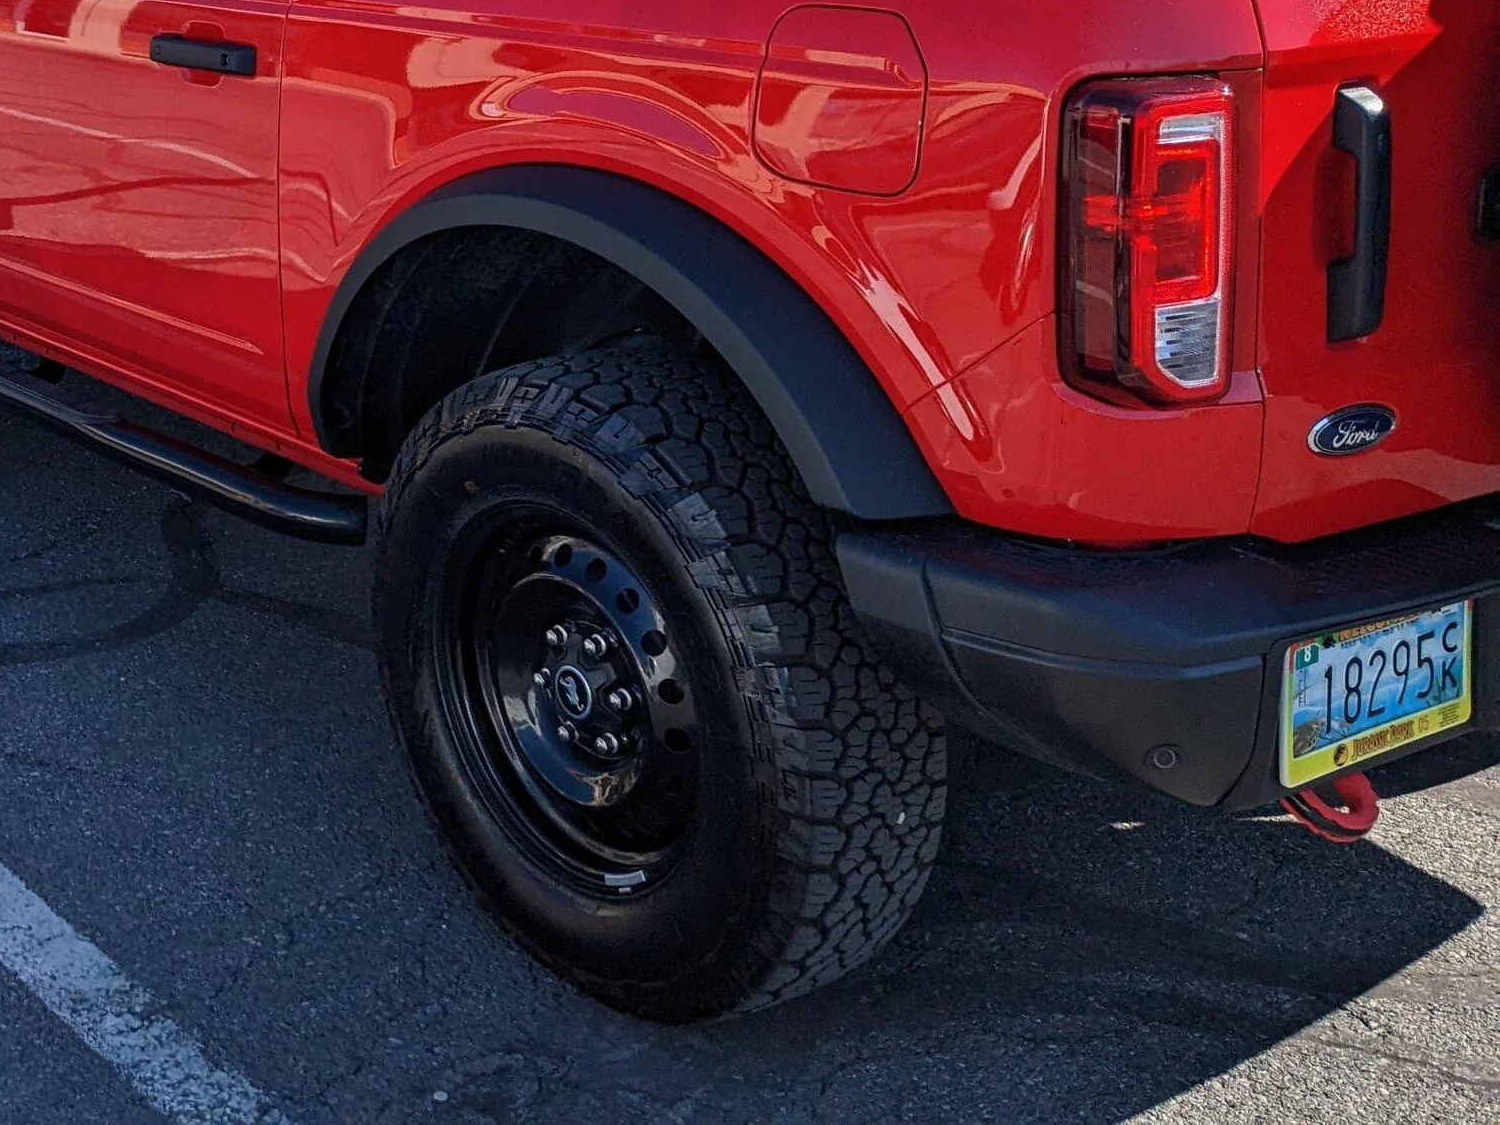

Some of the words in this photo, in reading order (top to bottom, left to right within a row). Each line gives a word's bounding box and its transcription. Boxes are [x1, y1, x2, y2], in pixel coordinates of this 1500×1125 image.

[1332, 420, 1380, 448] Ford
[1304, 645, 1312, 663] 8
[1351, 729, 1389, 761] JURASSIC
[1389, 720, 1415, 744] PARK
